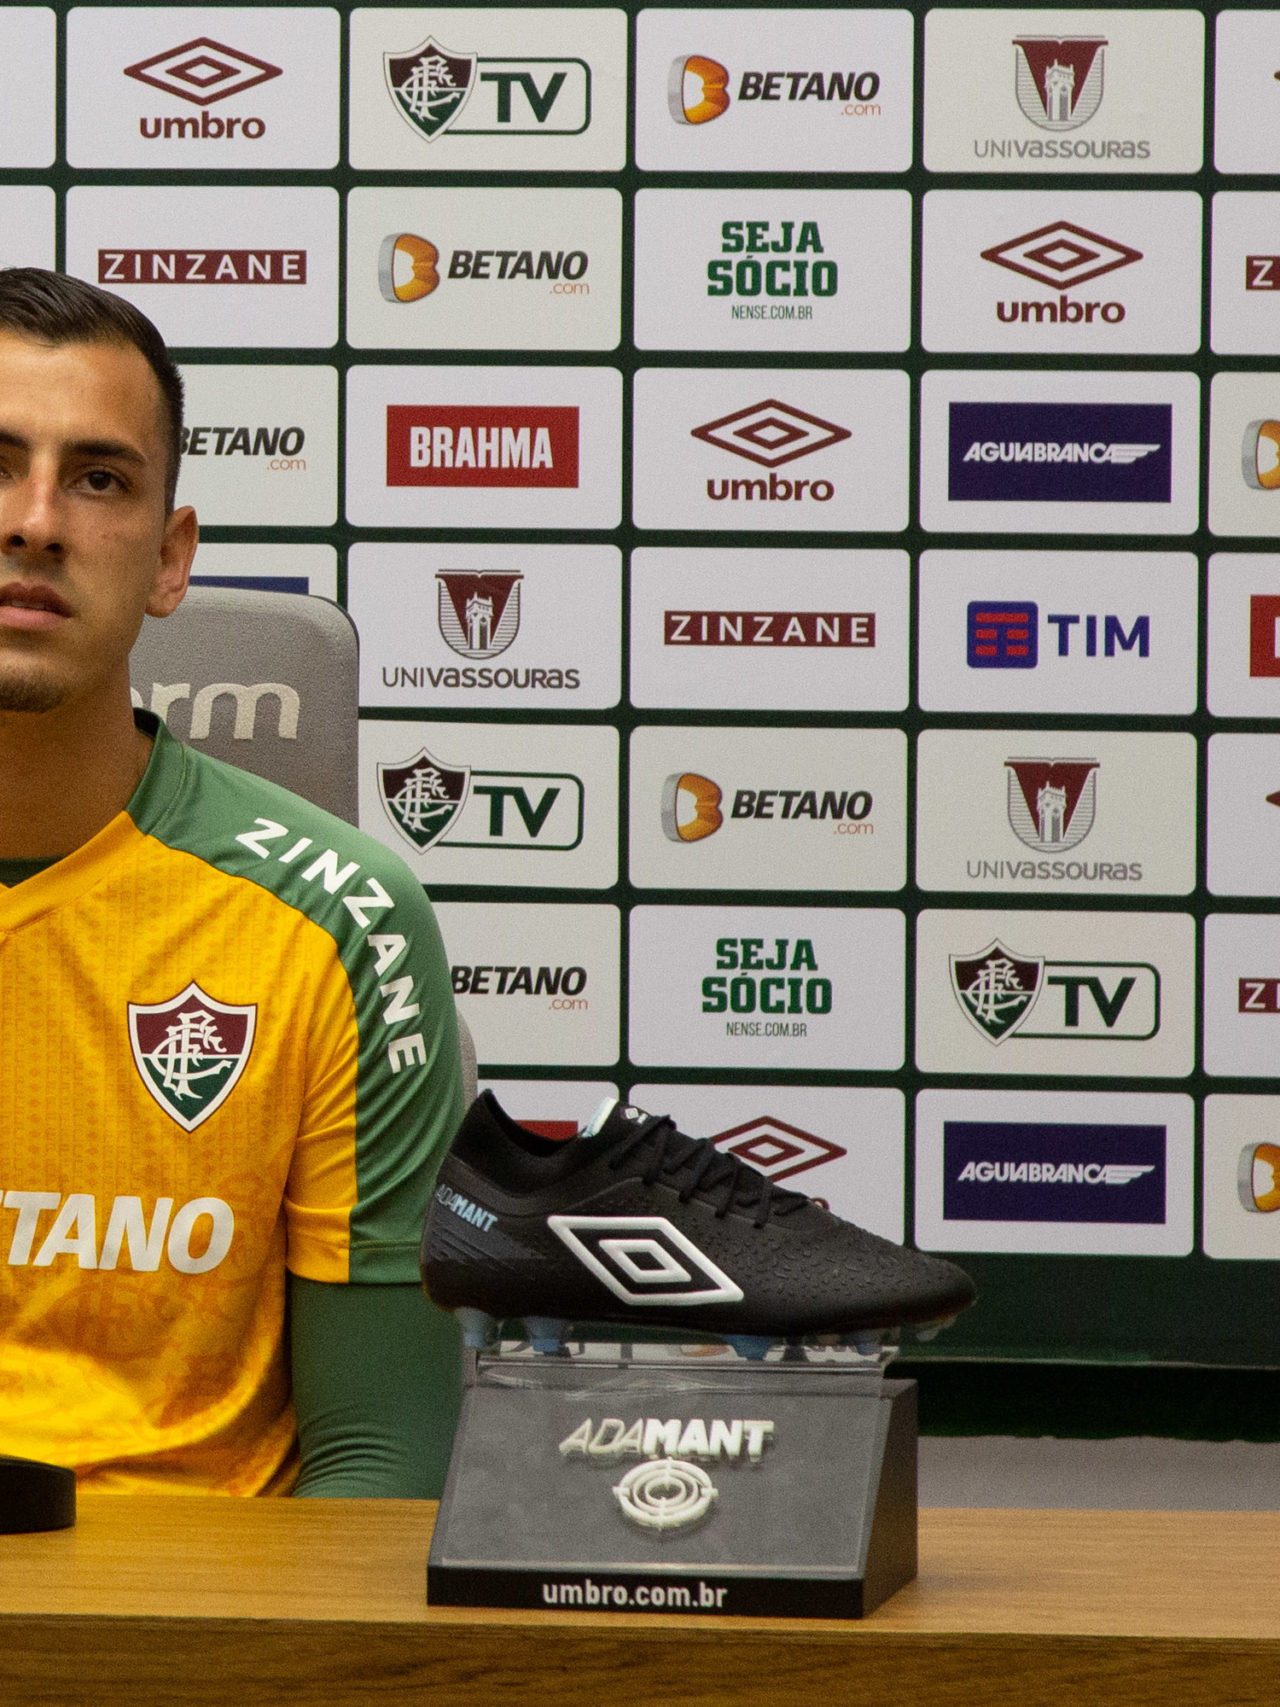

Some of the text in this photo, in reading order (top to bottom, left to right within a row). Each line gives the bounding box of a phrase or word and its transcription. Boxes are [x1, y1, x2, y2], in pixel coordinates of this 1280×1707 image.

[481, 73, 566, 122] TV
[738, 72, 880, 101] BETANO
[140, 111, 265, 139] umbro
[722, 222, 823, 253] SEJA
[104, 254, 301, 280] ZINZANE
[708, 256, 837, 296] SÓCIO
[732, 305, 812, 320] NENSE.COM.BR
[997, 295, 1125, 323] umbro
[411, 427, 553, 468] BRAHMA
[707, 473, 834, 501] umbro
[671, 615, 870, 641] ZINZANE
[1048, 615, 1149, 657] TIM
[474, 786, 560, 837] TV
[731, 790, 872, 820] BETANO
[235, 817, 427, 1073] ZINZANE
[717, 939, 818, 971] SEJA
[451, 966, 587, 995] BETANO
[451, 966, 587, 995] BETANO
[702, 973, 832, 1014] SÓCIO
[1048, 976, 1135, 1027] TV
[726, 1022, 807, 1037] NENSE.COM.BR
[559, 1418, 775, 1462] ADAMANT
[542, 1579, 728, 1608] umbro.com.br
